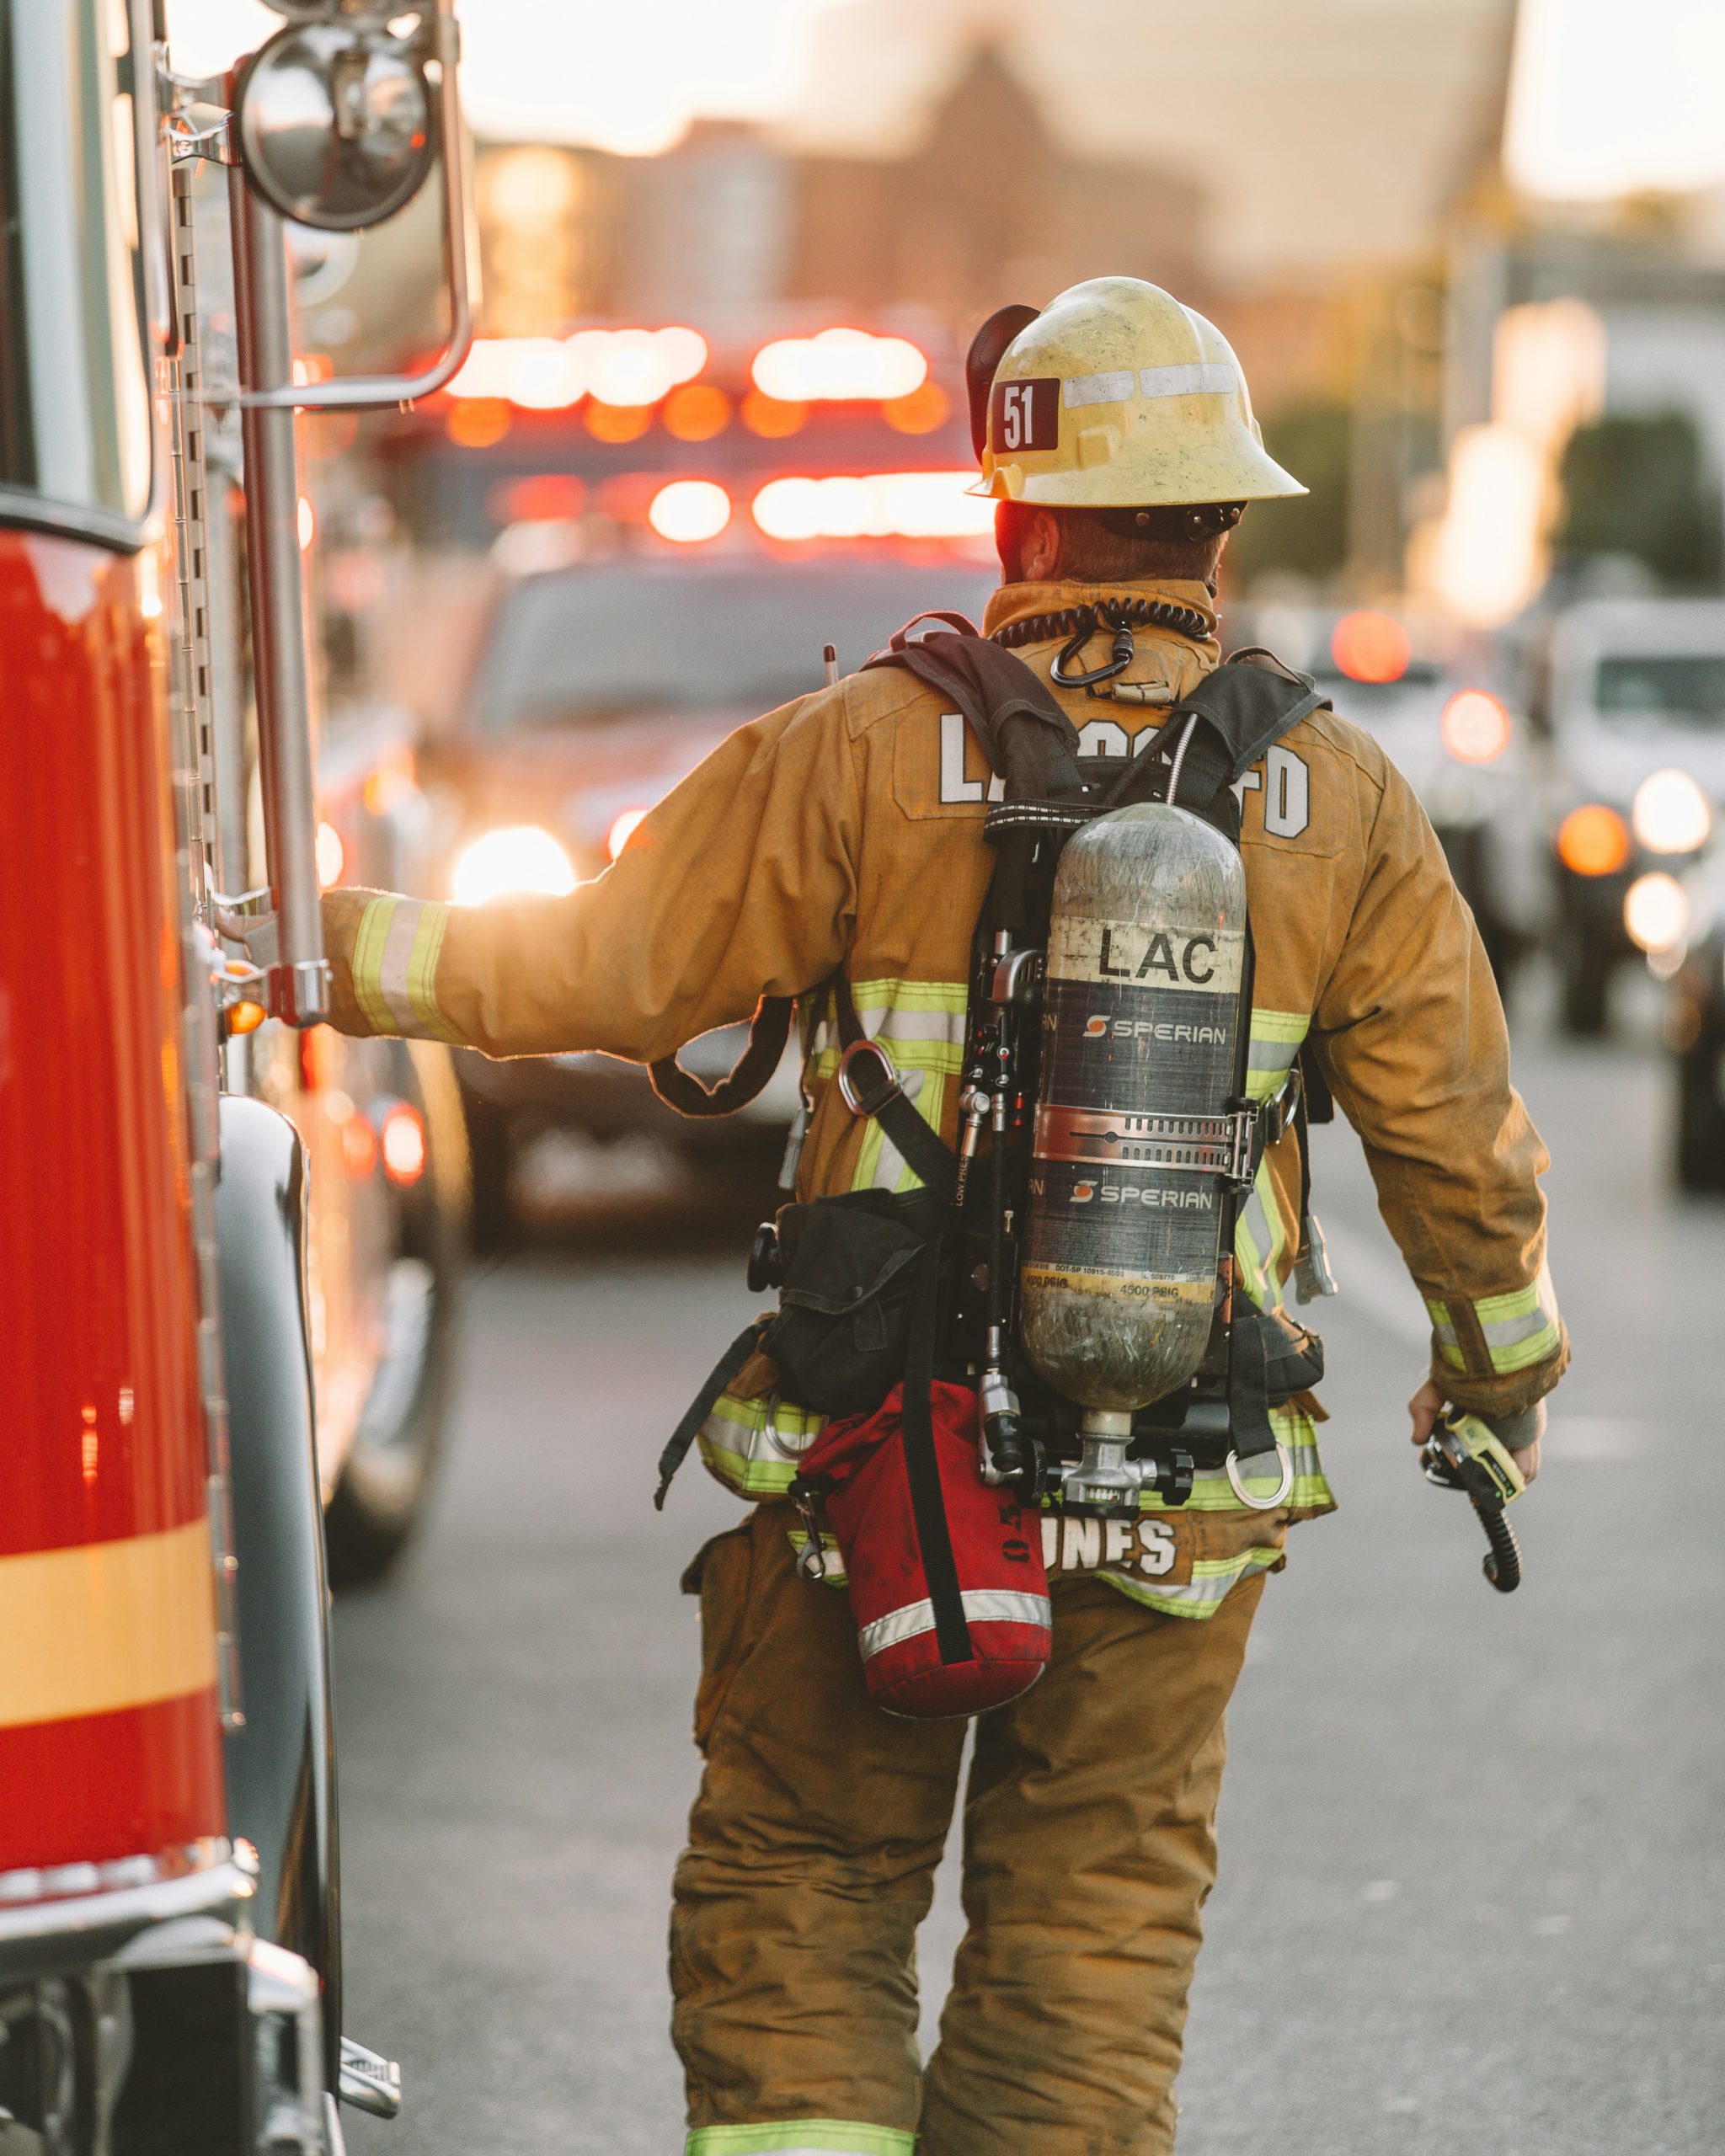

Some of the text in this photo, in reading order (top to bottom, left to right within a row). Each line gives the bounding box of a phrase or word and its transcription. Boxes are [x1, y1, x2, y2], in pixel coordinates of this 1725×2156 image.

[1003, 386, 1033, 450] 51
[1099, 929, 1219, 984] LAC
[1113, 1020, 1226, 1044] SPERIAN
[1100, 1185, 1213, 1209] SPERIAN
[1055, 1264, 1081, 1273] DOT-SP
[1119, 1283, 1149, 1296] 4500
